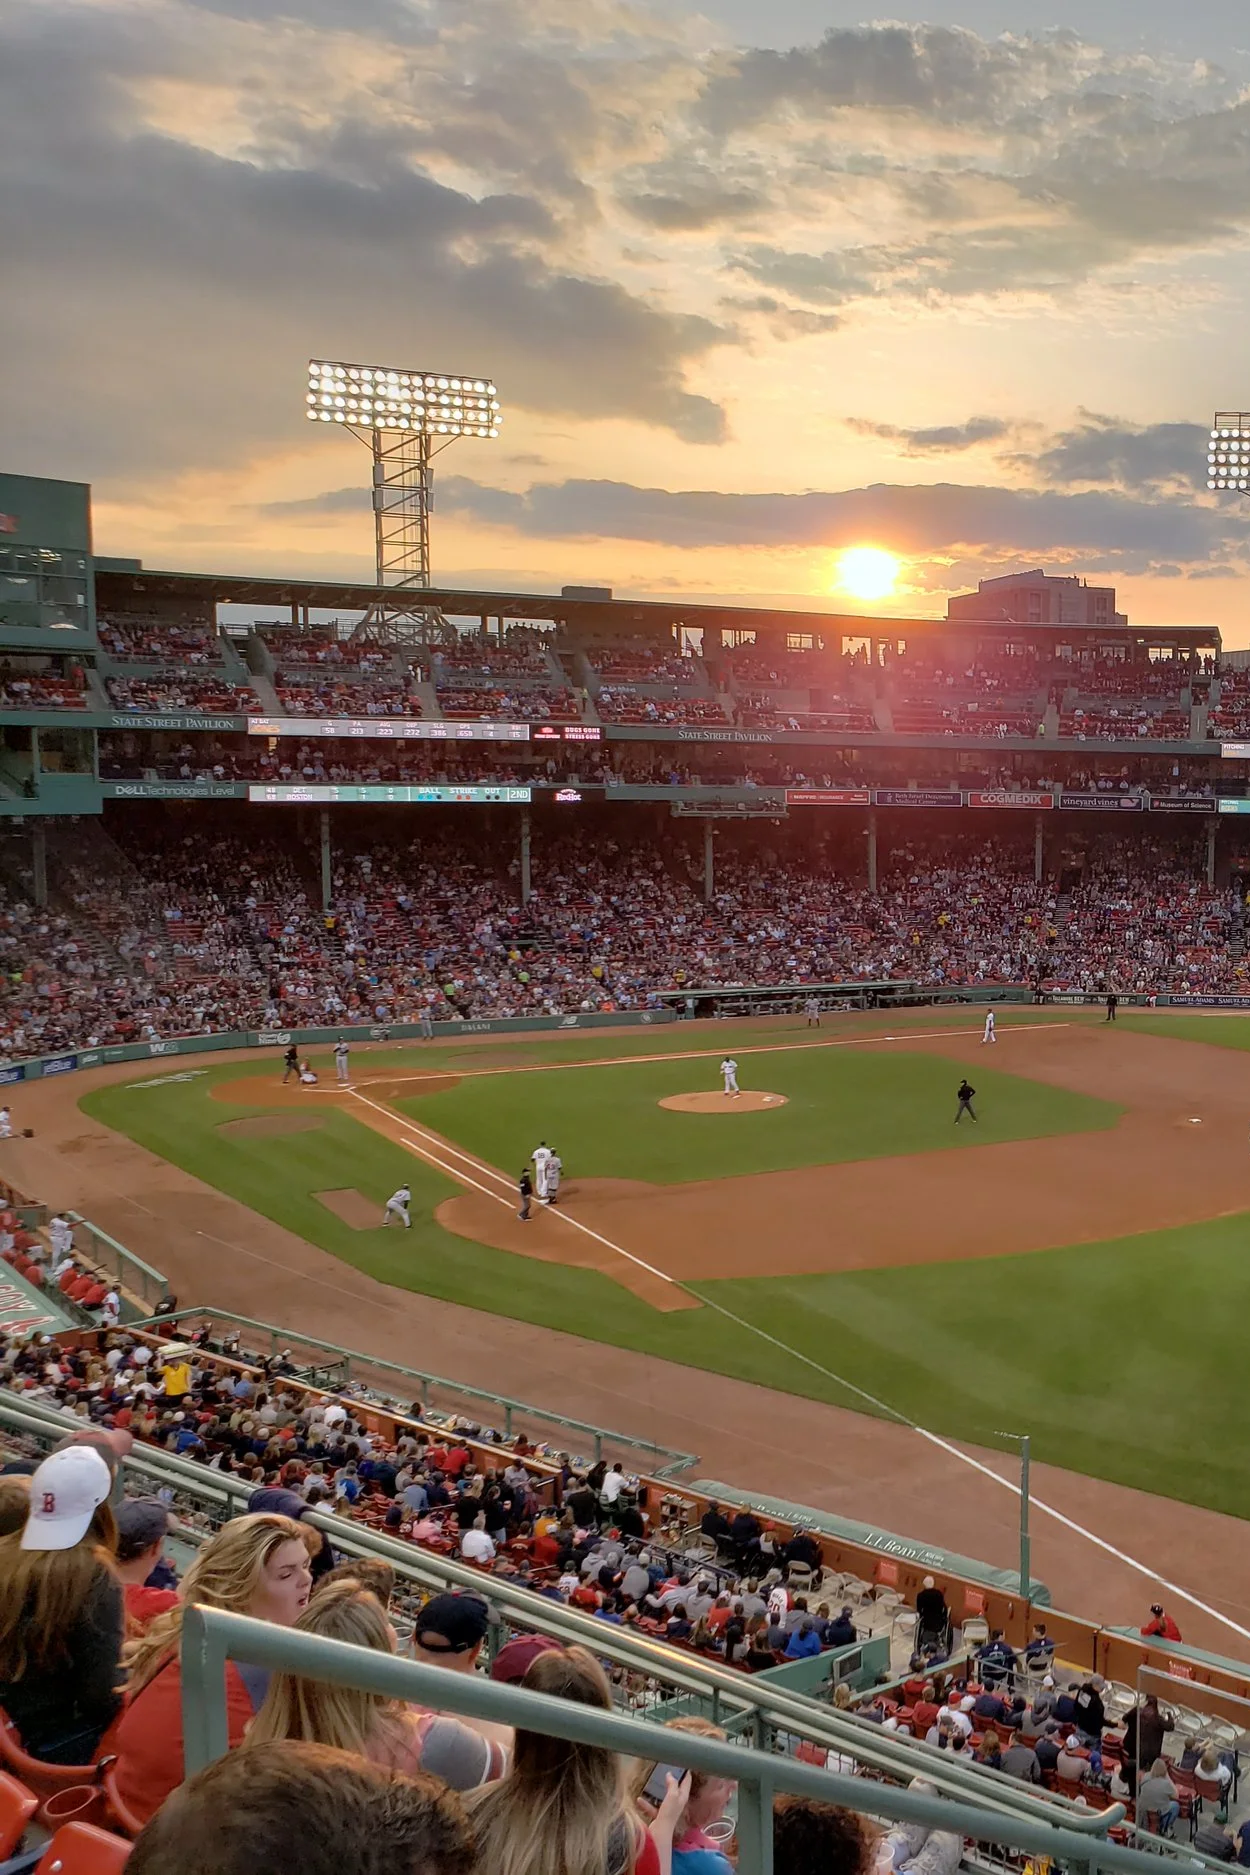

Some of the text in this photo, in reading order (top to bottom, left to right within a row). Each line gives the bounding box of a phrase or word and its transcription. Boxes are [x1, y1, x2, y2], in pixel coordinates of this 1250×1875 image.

[112, 716, 234, 729] STATE STREET PAVILION
[678, 730, 772, 742] STATE STREET PAVILION
[115, 785, 235, 797] DELL Technologies Level
[510, 790, 528, 799] 2ND
[980, 794, 1042, 804] COGMEDIX
[1063, 798, 1119, 807] vineyard vines
[1171, 996, 1194, 1004] SAMUEL
[1194, 996, 1215, 1004] ADAMS
[43, 1060, 72, 1075] jetBlue
[42, 1492, 55, 1513] B
[864, 1532, 917, 1560] L.L.Bean
